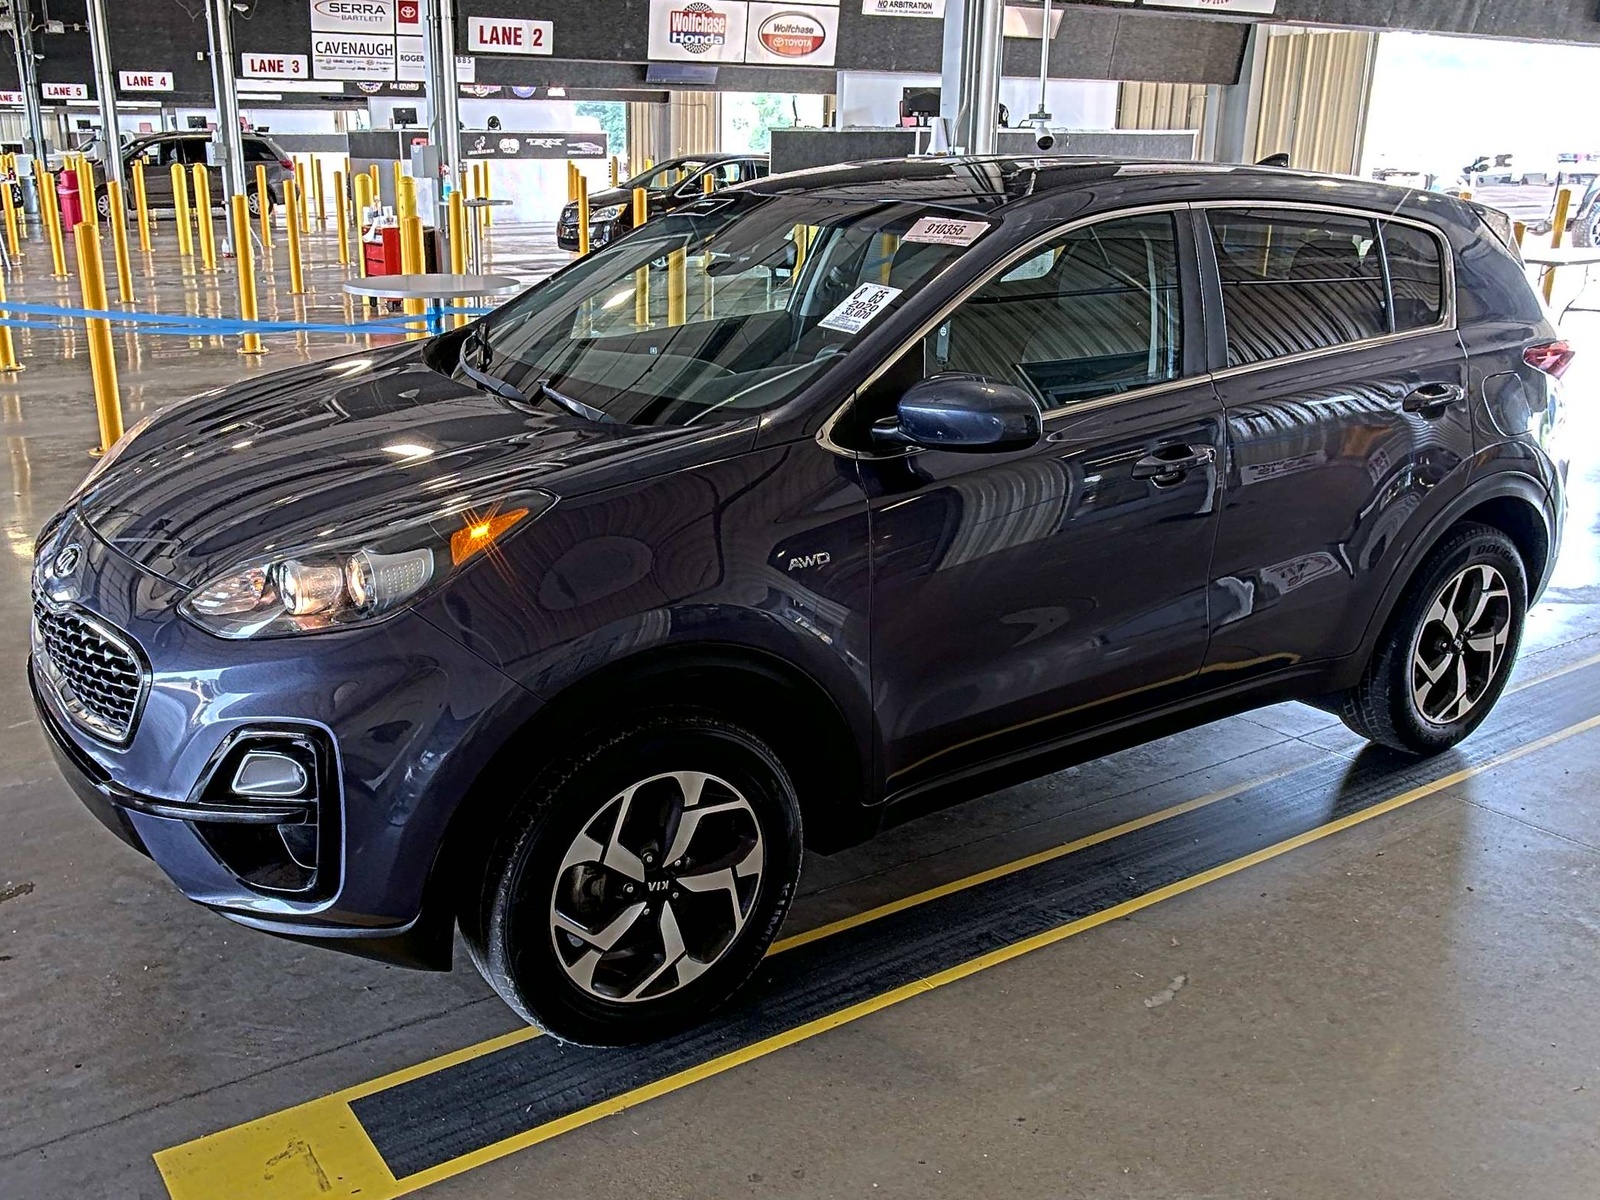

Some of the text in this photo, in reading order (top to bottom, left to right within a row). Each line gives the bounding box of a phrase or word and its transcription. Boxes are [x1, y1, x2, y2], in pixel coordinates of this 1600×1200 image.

[329, 2, 386, 15] SERRA
[889, 1, 933, 9] ARBITRATION
[672, 12, 726, 32] Wolfchase
[773, 23, 815, 35] Wolfchase
[479, 25, 543, 47] LANE 2
[672, 33, 724, 45] Honda
[784, 37, 812, 47] TOYOTA
[315, 41, 393, 56] CAVENAUGH
[400, 54, 425, 63] ROGER
[250, 58, 285, 73] LANE
[291, 60, 301, 74] 3
[126, 75, 167, 87] LANE 4
[47, 87, 82, 97] LANE 5
[924, 223, 966, 235] 910356
[852, 287, 889, 304] 8 65
[848, 300, 879, 312] 2020
[842, 306, 872, 320] 33,070
[788, 552, 831, 571] AWD
[647, 880, 670, 891] KIA
